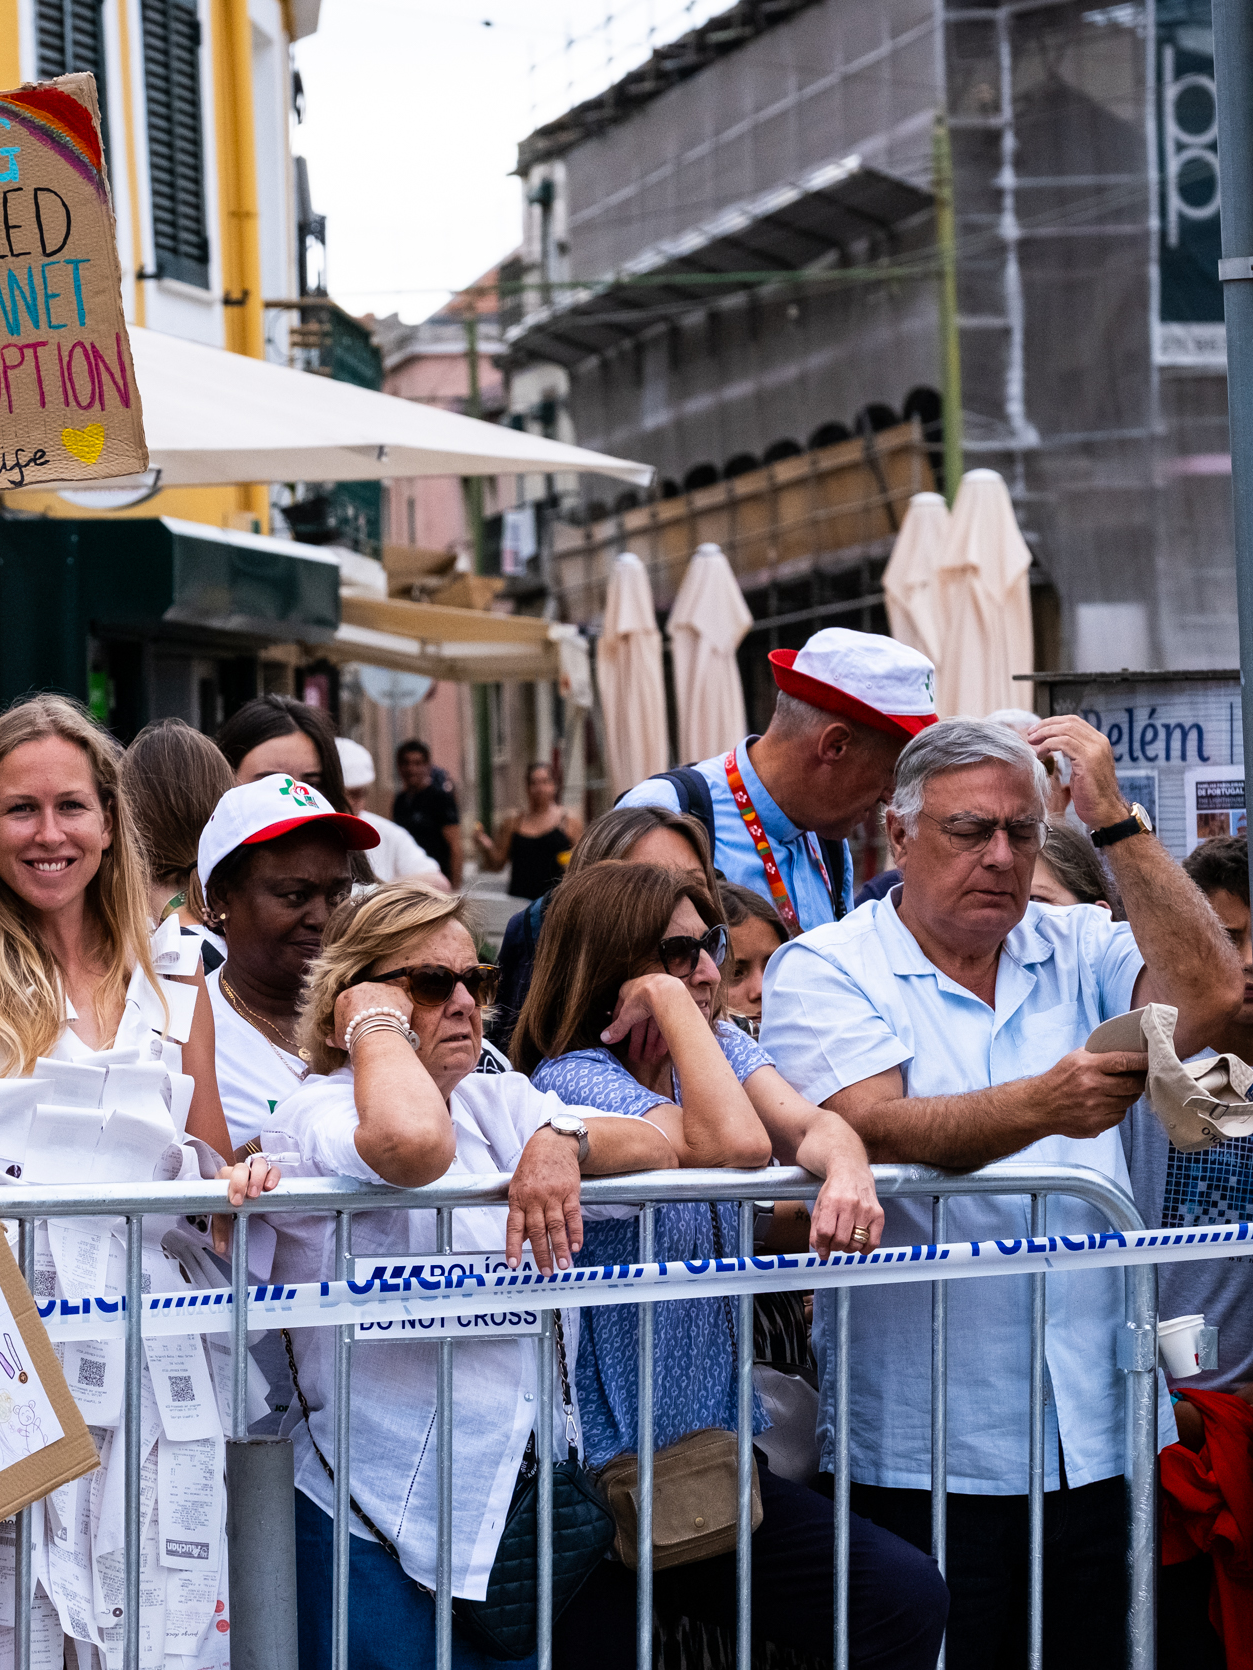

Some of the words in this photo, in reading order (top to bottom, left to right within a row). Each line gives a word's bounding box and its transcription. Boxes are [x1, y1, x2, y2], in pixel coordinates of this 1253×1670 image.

[1207, 787, 1245, 796] PORTUGAL
[359, 1320, 393, 1331] DO
[457, 1309, 538, 1327] CROSS
[167, 1542, 201, 1558] Auchan
